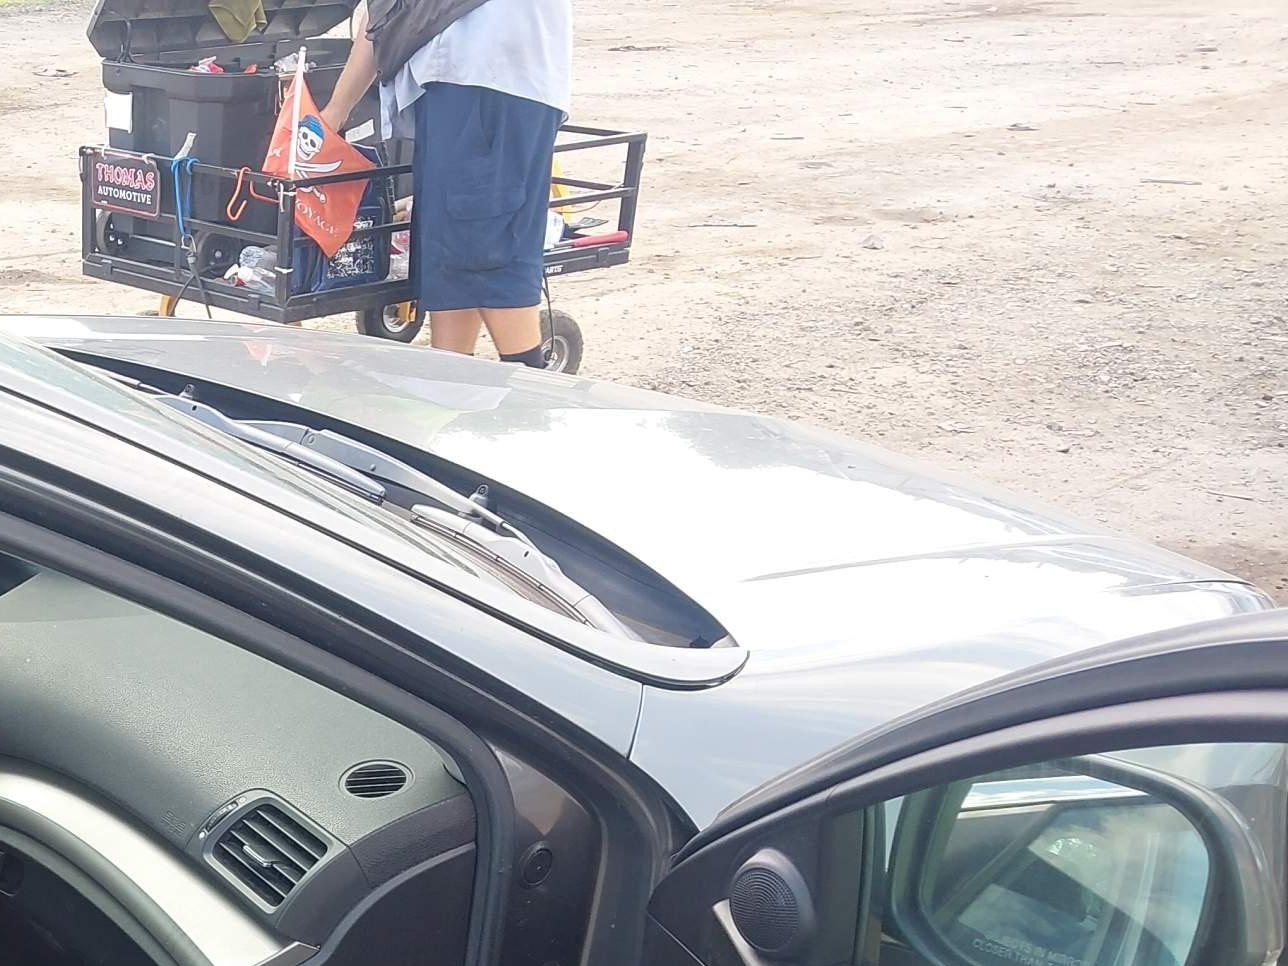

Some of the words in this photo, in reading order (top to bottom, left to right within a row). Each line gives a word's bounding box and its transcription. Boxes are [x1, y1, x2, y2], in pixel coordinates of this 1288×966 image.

[95, 162, 155, 191] THOMAS
[97, 185, 152, 205] AUTOMOTIVE
[972, 938, 1013, 960] CLOSER
